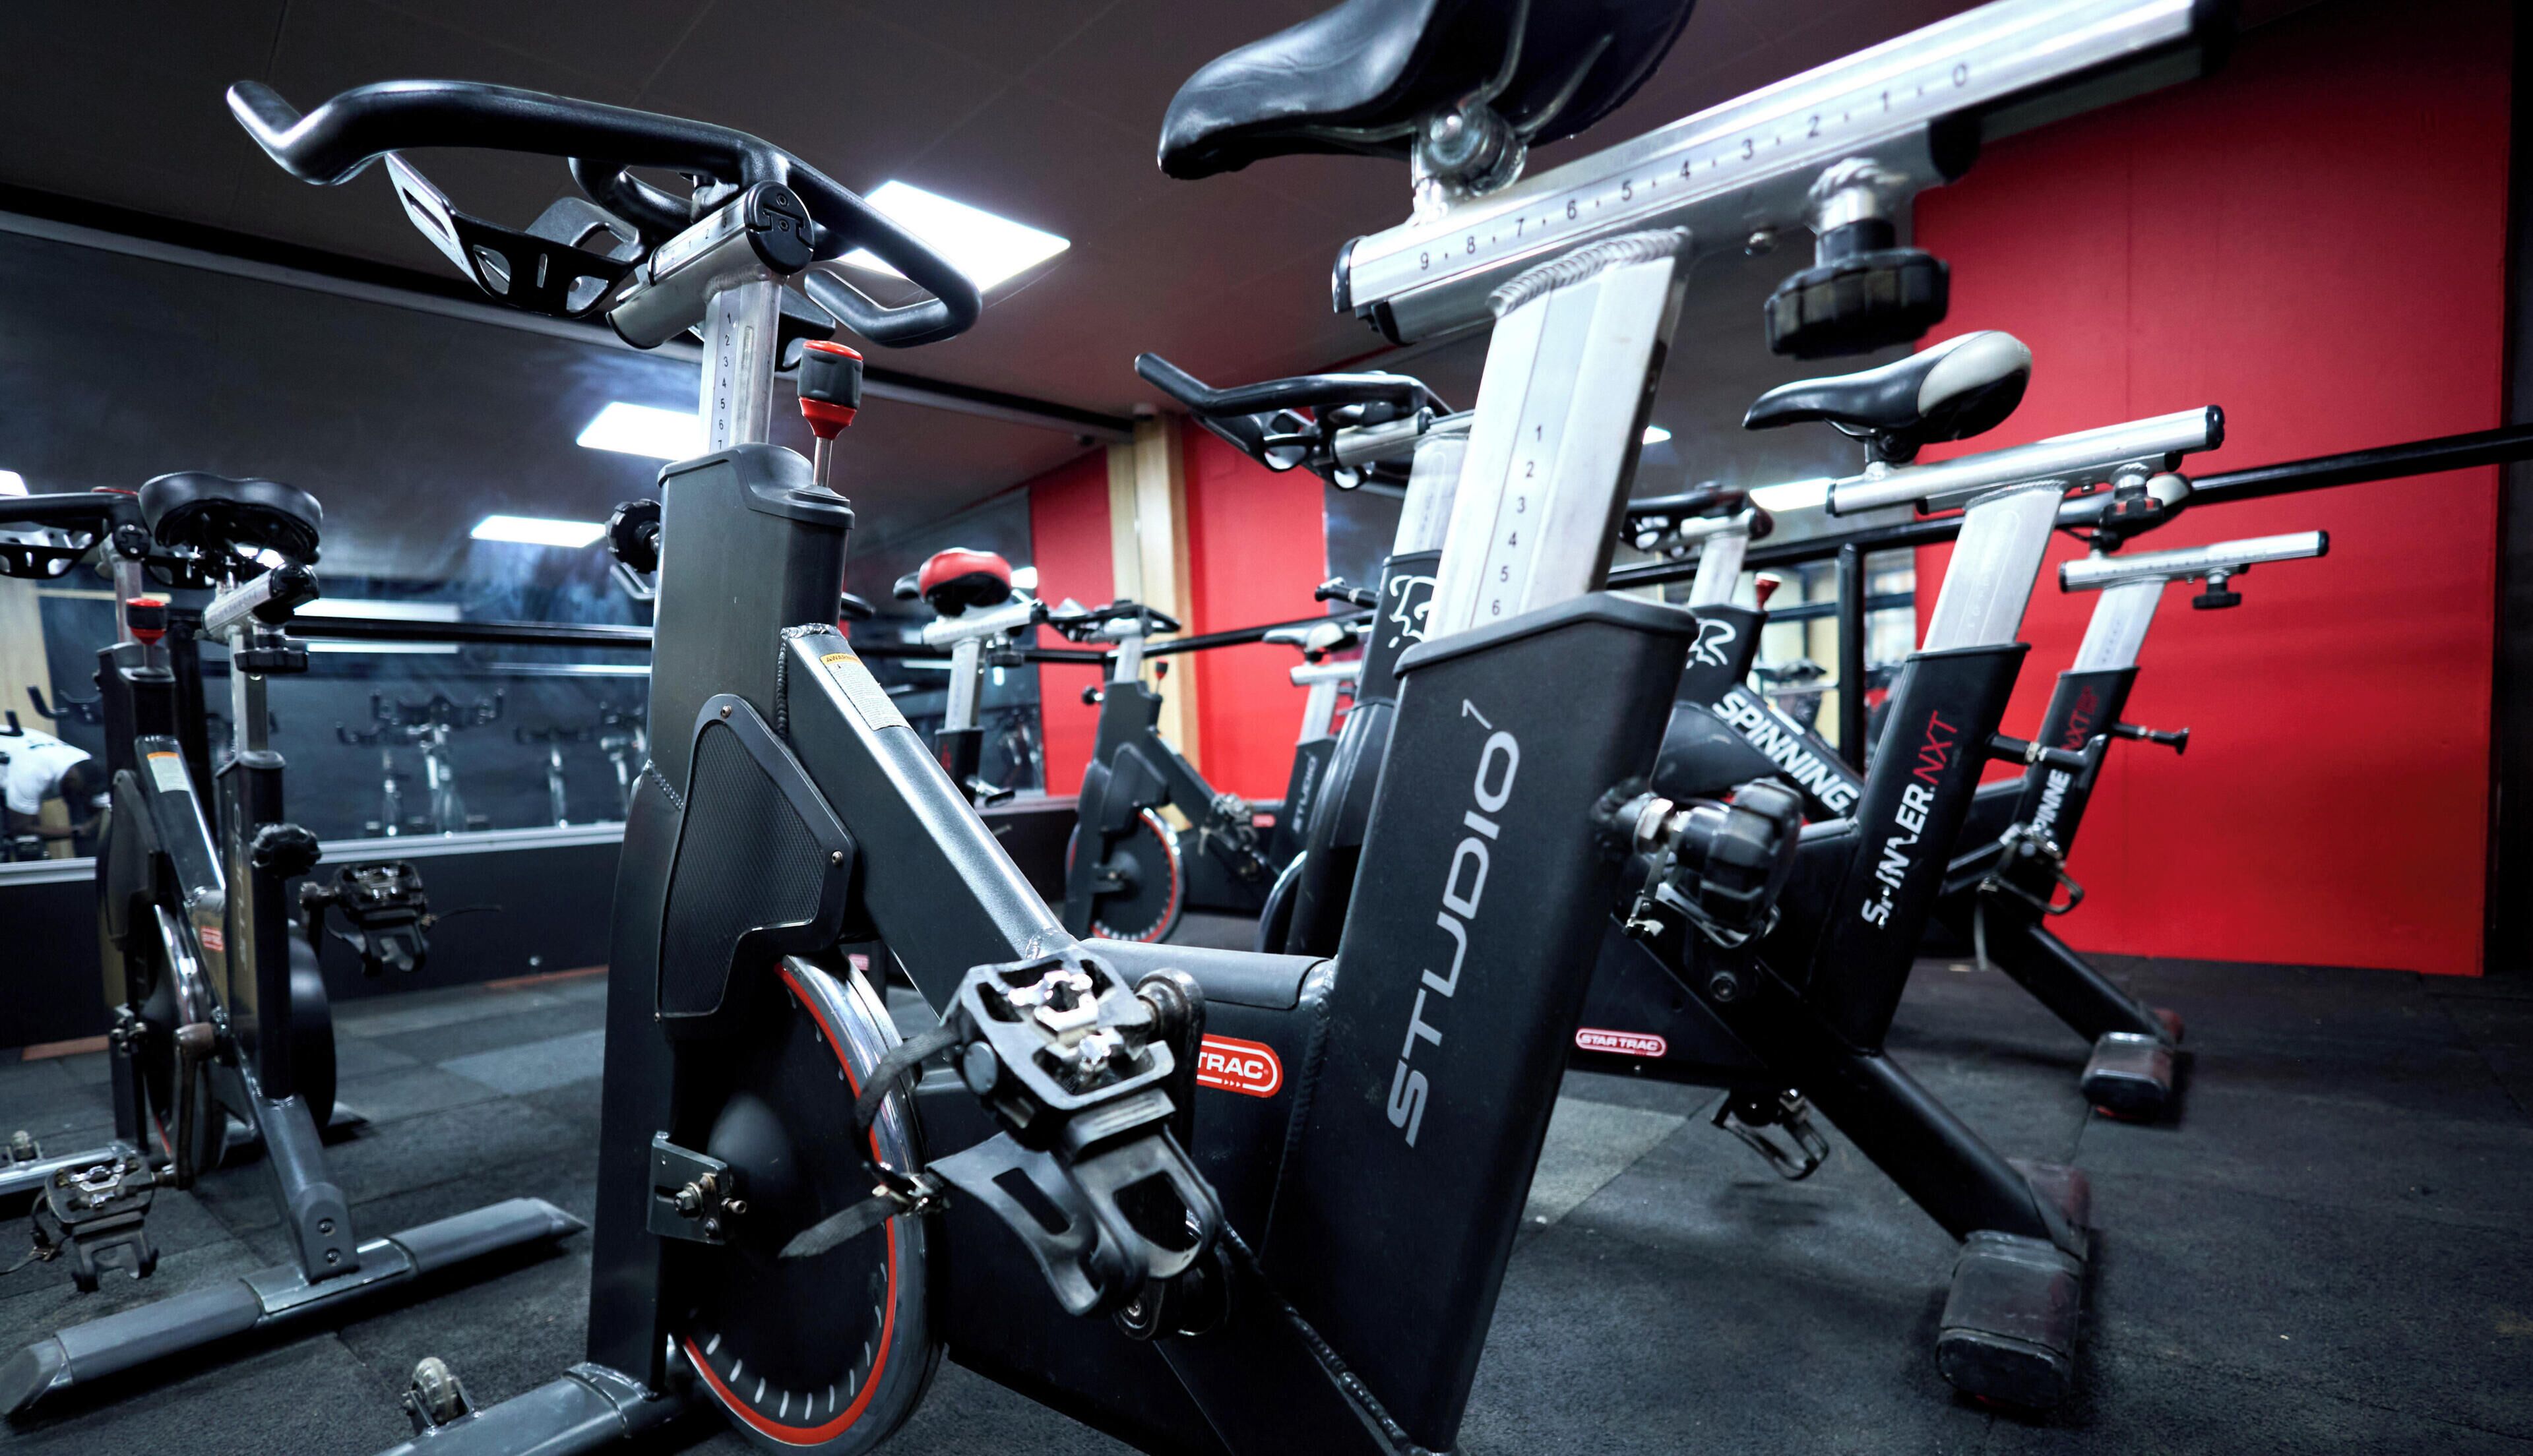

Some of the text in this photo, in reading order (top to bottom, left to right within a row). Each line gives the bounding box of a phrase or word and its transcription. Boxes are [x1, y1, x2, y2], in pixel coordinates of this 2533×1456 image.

[1420, 63, 1967, 271] 9 8 7 6 5 4 3 2 1 0
[727, 313, 731, 324] 1
[725, 335, 730, 346] 2
[723, 357, 728, 367] 3
[722, 378, 726, 388] 4
[720, 398, 726, 410] 5
[718, 419, 724, 430] 6
[1535, 424, 1543, 441] 1
[718, 440, 722, 450] 7
[1525, 461, 1534, 477] 2
[1517, 496, 1526, 514] 3
[1508, 531, 1517, 547] 4
[1500, 566, 1509, 582] 5
[1491, 599, 1501, 616] 6
[1712, 691, 1860, 812] SPINNING
[2032, 769, 2071, 830] PINNE
[1861, 710, 1958, 929] SINER NXT
[1387, 731, 1520, 1148] STUDIO
[1581, 1033, 1658, 1051] STAR TRAC
